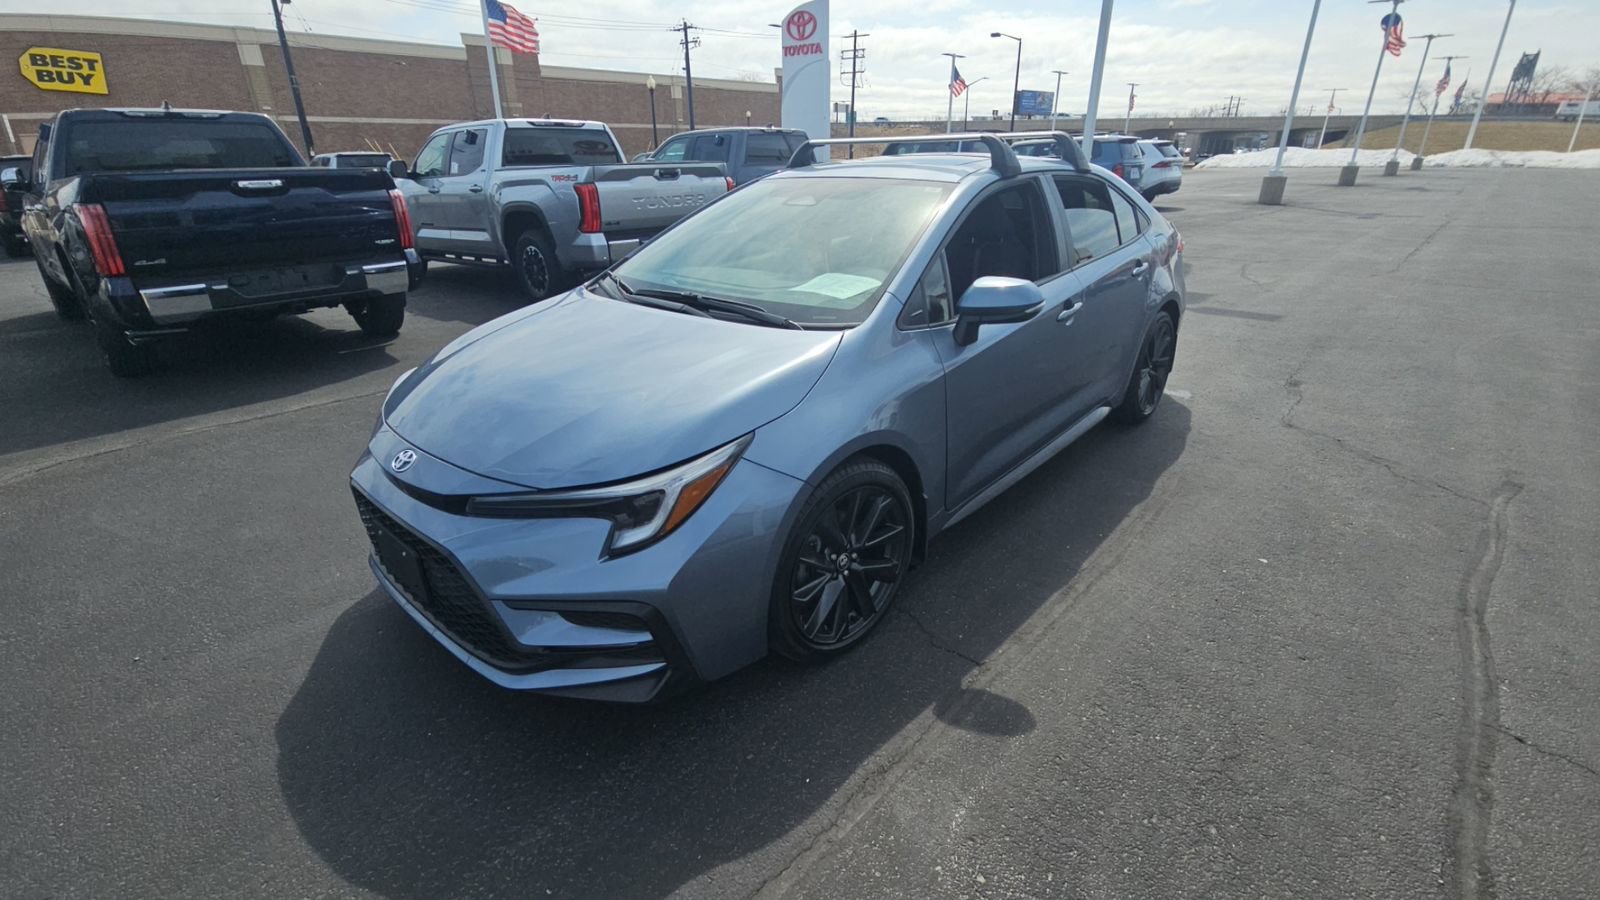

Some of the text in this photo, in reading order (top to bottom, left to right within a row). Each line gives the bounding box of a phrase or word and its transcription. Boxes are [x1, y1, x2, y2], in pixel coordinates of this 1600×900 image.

[783, 43, 823, 56] TOYOTA
[29, 54, 99, 71] BEST
[36, 70, 95, 86] BUY
